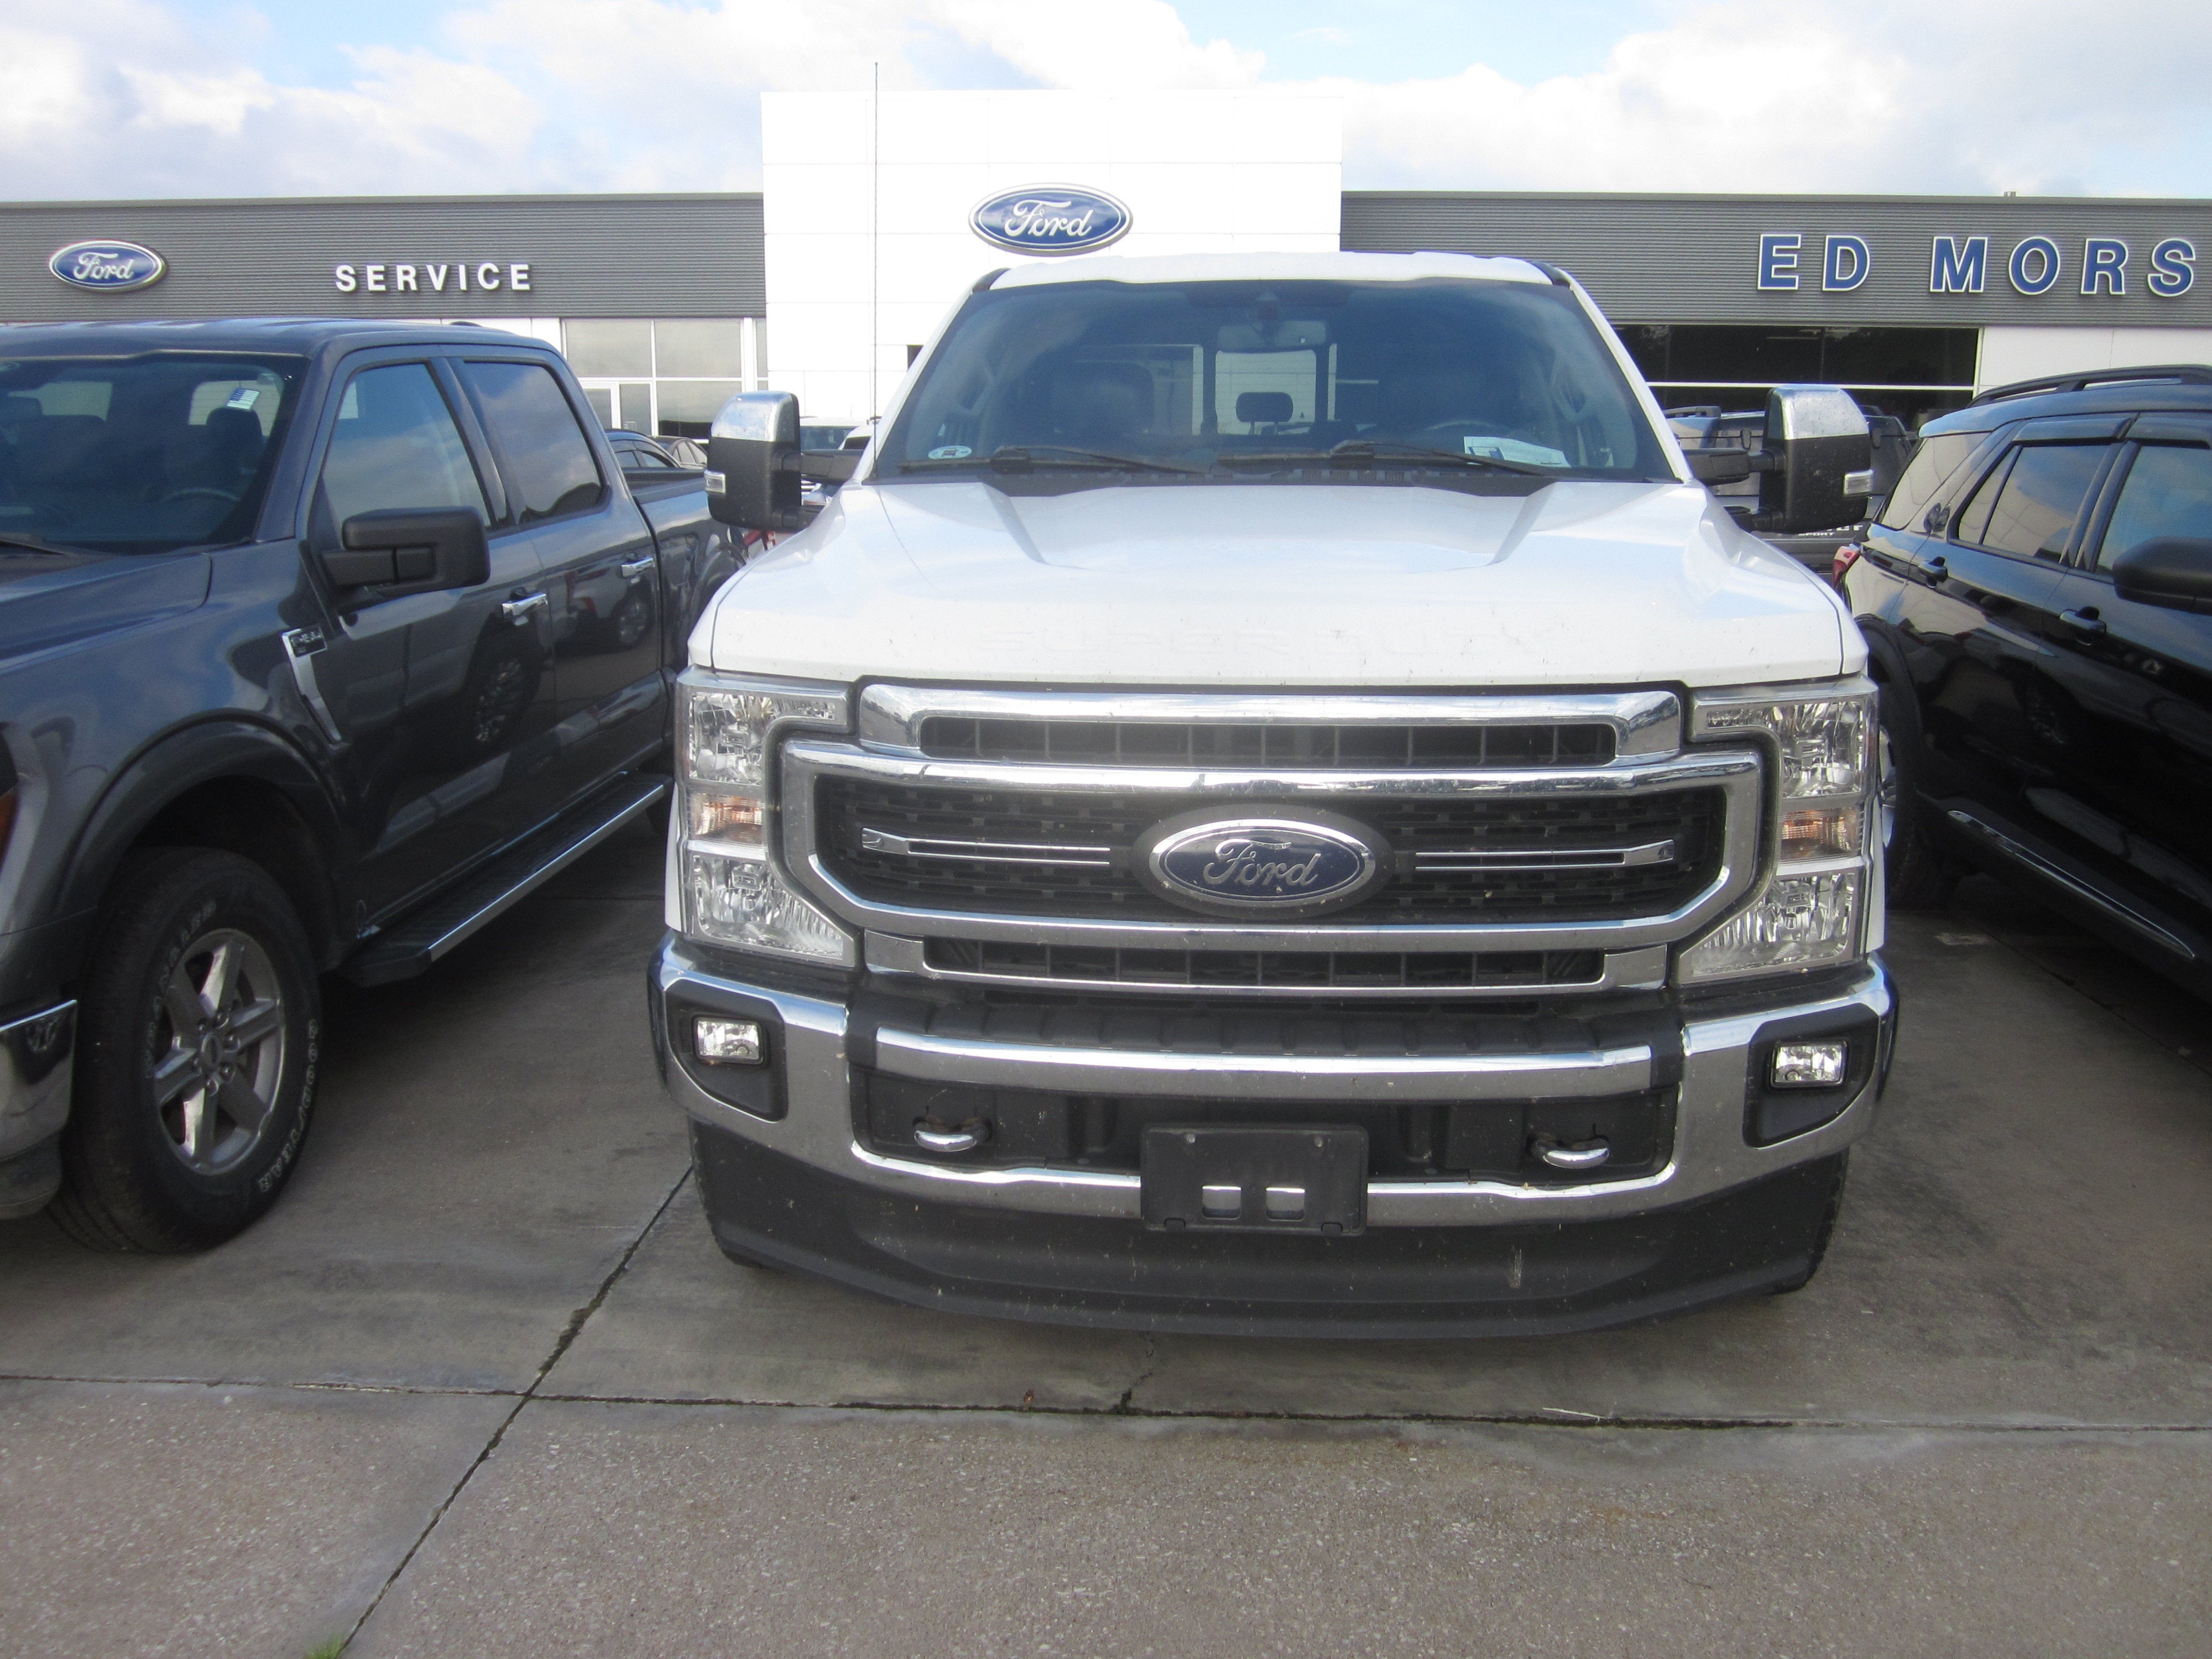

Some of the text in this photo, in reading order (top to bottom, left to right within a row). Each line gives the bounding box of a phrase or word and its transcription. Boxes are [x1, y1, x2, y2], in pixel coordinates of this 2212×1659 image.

[1004, 199, 1094, 237] Ford
[73, 252, 134, 279] Ford
[335, 262, 531, 292] SERVICE
[1757, 233, 2197, 298] ED MORS
[977, 627, 1297, 655] SUPER
[1202, 838, 1321, 886] Ford
